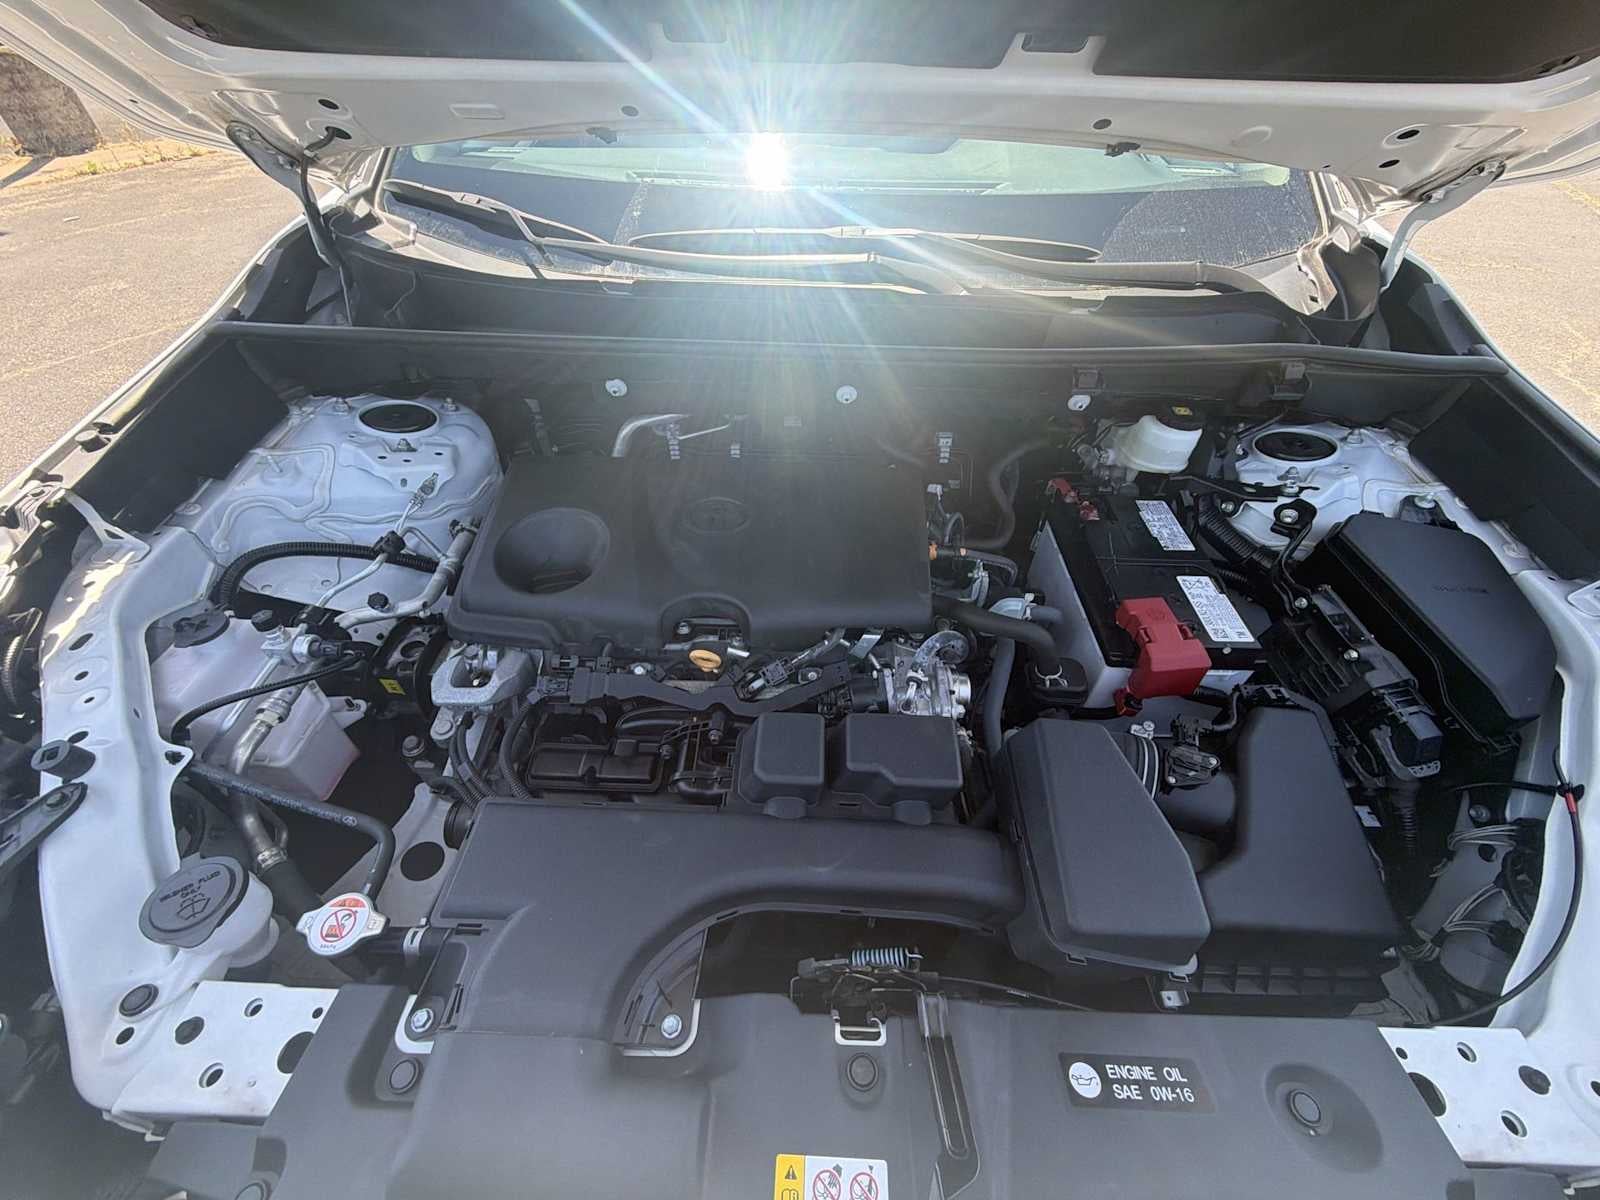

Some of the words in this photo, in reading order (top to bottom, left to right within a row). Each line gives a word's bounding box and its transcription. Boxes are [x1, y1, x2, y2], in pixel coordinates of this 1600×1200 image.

[1105, 1064, 1157, 1081] ENGINE
[1163, 1067, 1188, 1082] OIL
[1112, 1084, 1143, 1100] SAE
[1150, 1086, 1195, 1103] 0W-16
